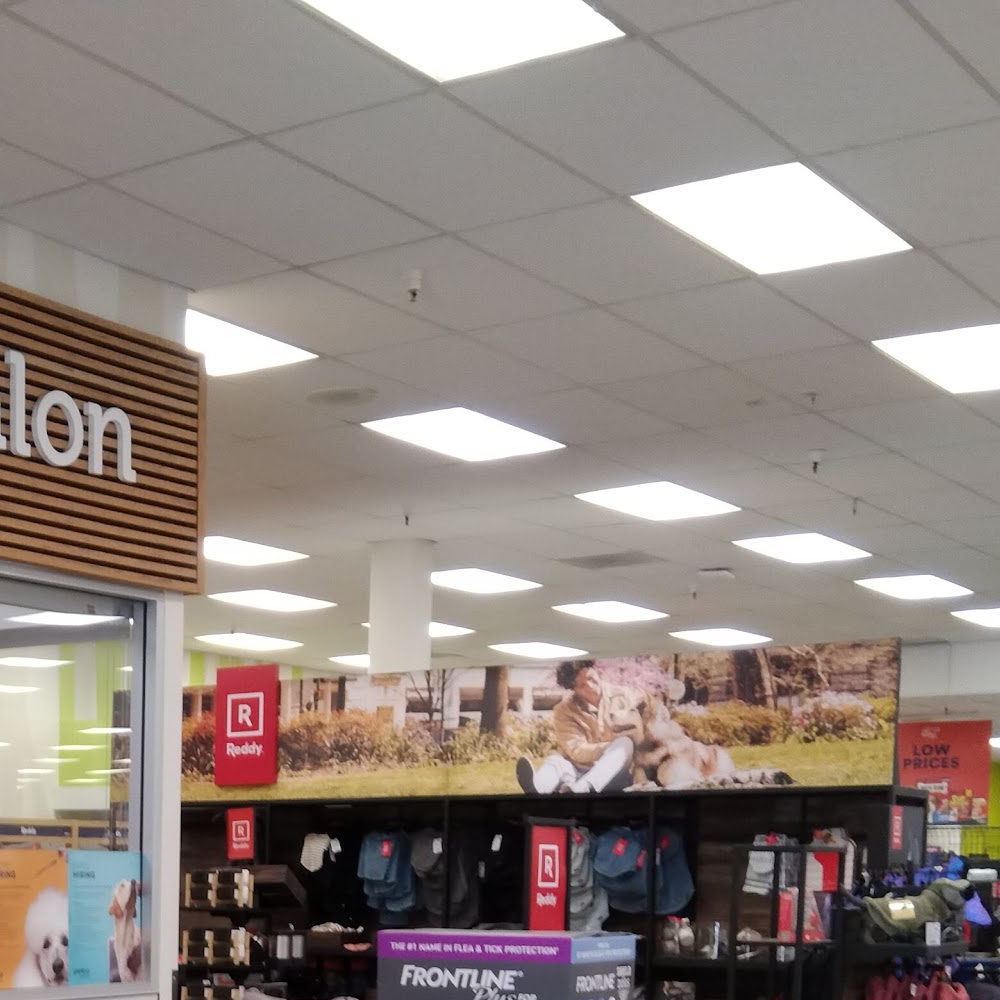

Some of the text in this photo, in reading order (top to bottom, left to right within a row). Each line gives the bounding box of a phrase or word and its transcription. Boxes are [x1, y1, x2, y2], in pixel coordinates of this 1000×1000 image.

[237, 703, 253, 727] R
[226, 741, 264, 757] Reddy
[912, 743, 951, 757] LOW
[903, 757, 960, 769] PRICES
[390, 941, 406, 950] THE
[406, 942, 417, 950] #1
[418, 942, 444, 952] NAME
[443, 943, 453, 952] IN
[453, 943, 475, 954] FLEA
[483, 944, 503, 954] TICK
[400, 964, 515, 991] FRONTLINE
[576, 973, 616, 993] FRONTLINE
